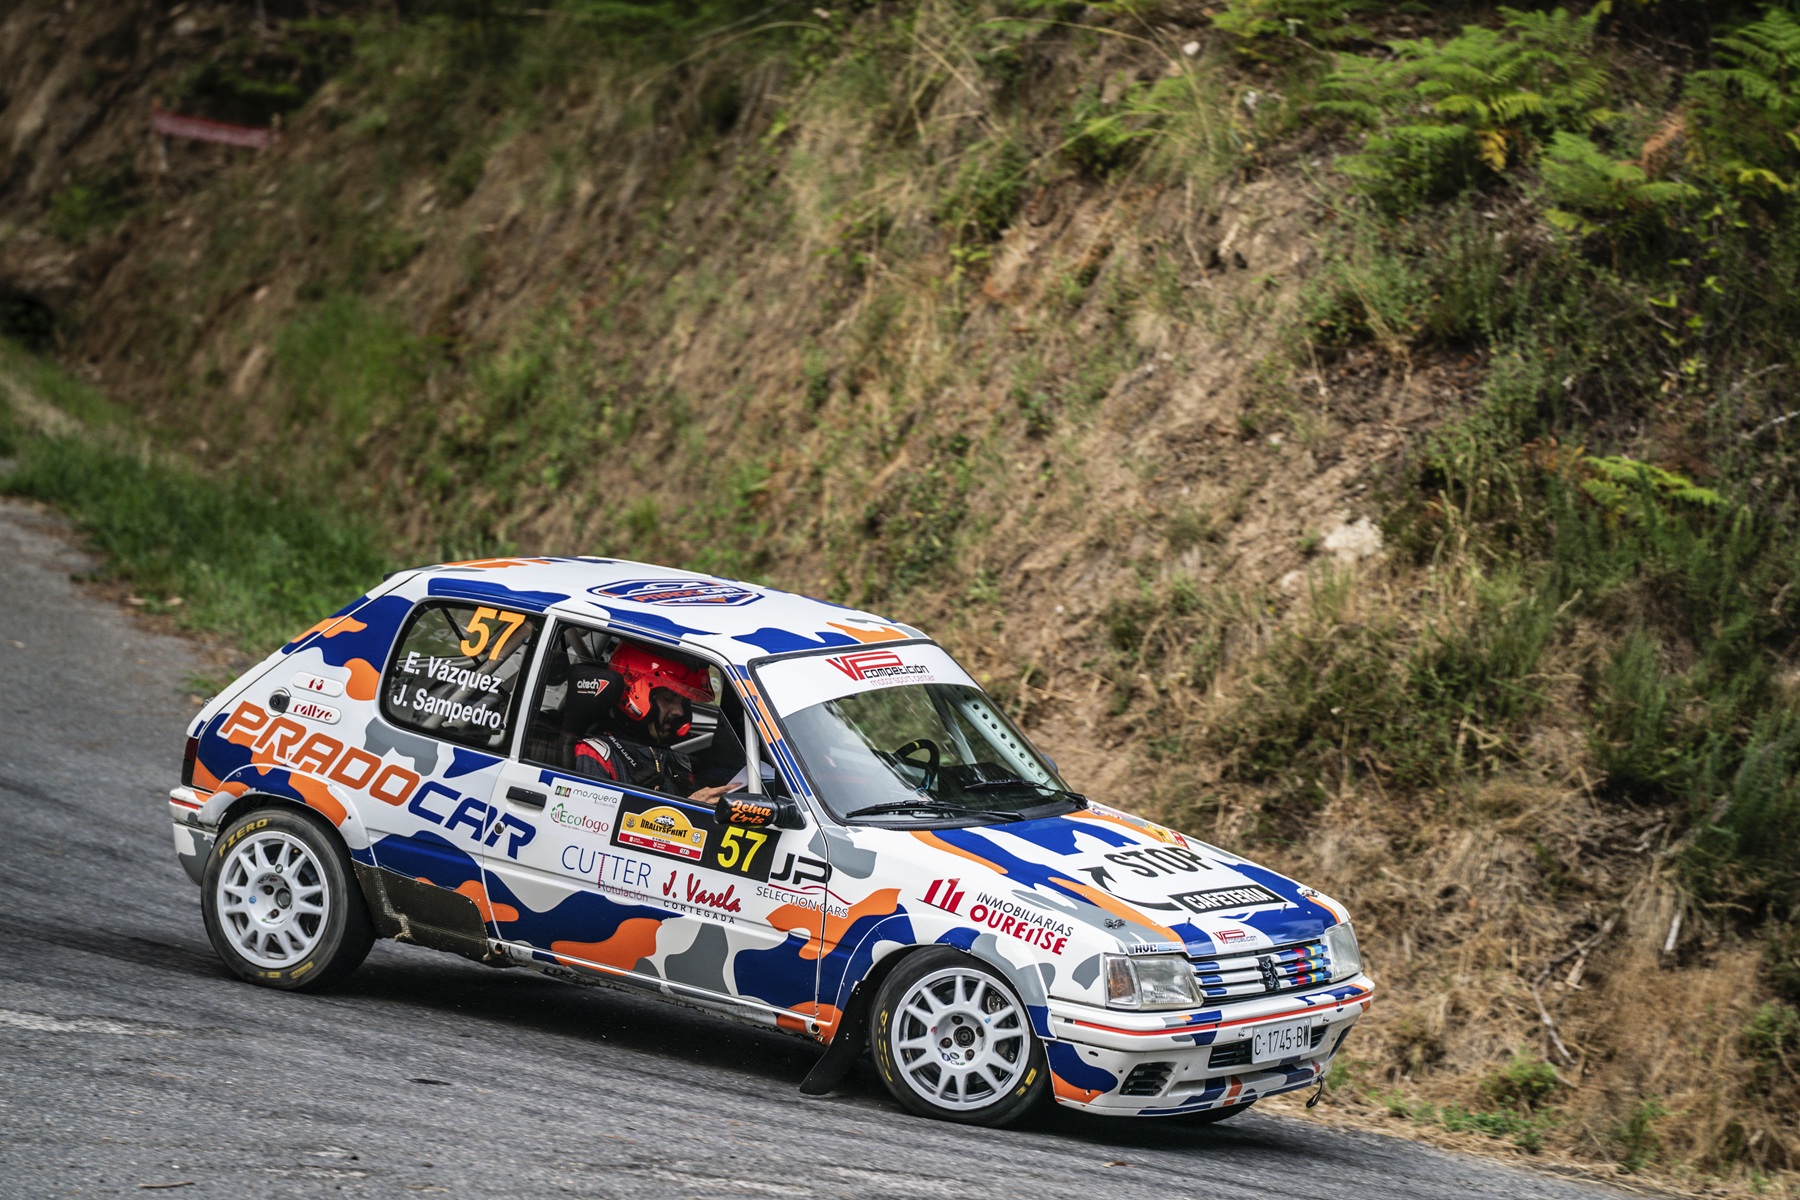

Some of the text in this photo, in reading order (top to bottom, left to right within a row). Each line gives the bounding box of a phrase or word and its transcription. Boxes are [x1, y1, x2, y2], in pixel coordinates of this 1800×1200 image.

[460, 606, 526, 660] 57
[404, 651, 502, 694] E. Vázquez
[863, 664, 930, 677] competición
[293, 703, 333, 721] rallye
[393, 684, 502, 729] J. Sampedro
[572, 788, 618, 804] mosquera
[730, 812, 765, 824] Cris
[717, 826, 768, 873] 57
[1104, 846, 1214, 878] STOP
[561, 845, 652, 889] CUTTER
[770, 853, 832, 885] JP
[598, 879, 649, 902] Rotulación
[663, 870, 742, 913] J. Varela
[756, 886, 849, 919] SELECTION CARS
[1183, 888, 1275, 910] CAFETERIA
[663, 900, 736, 925] CORTEGADA
[976, 892, 1074, 937] INMOBILIARIAS
